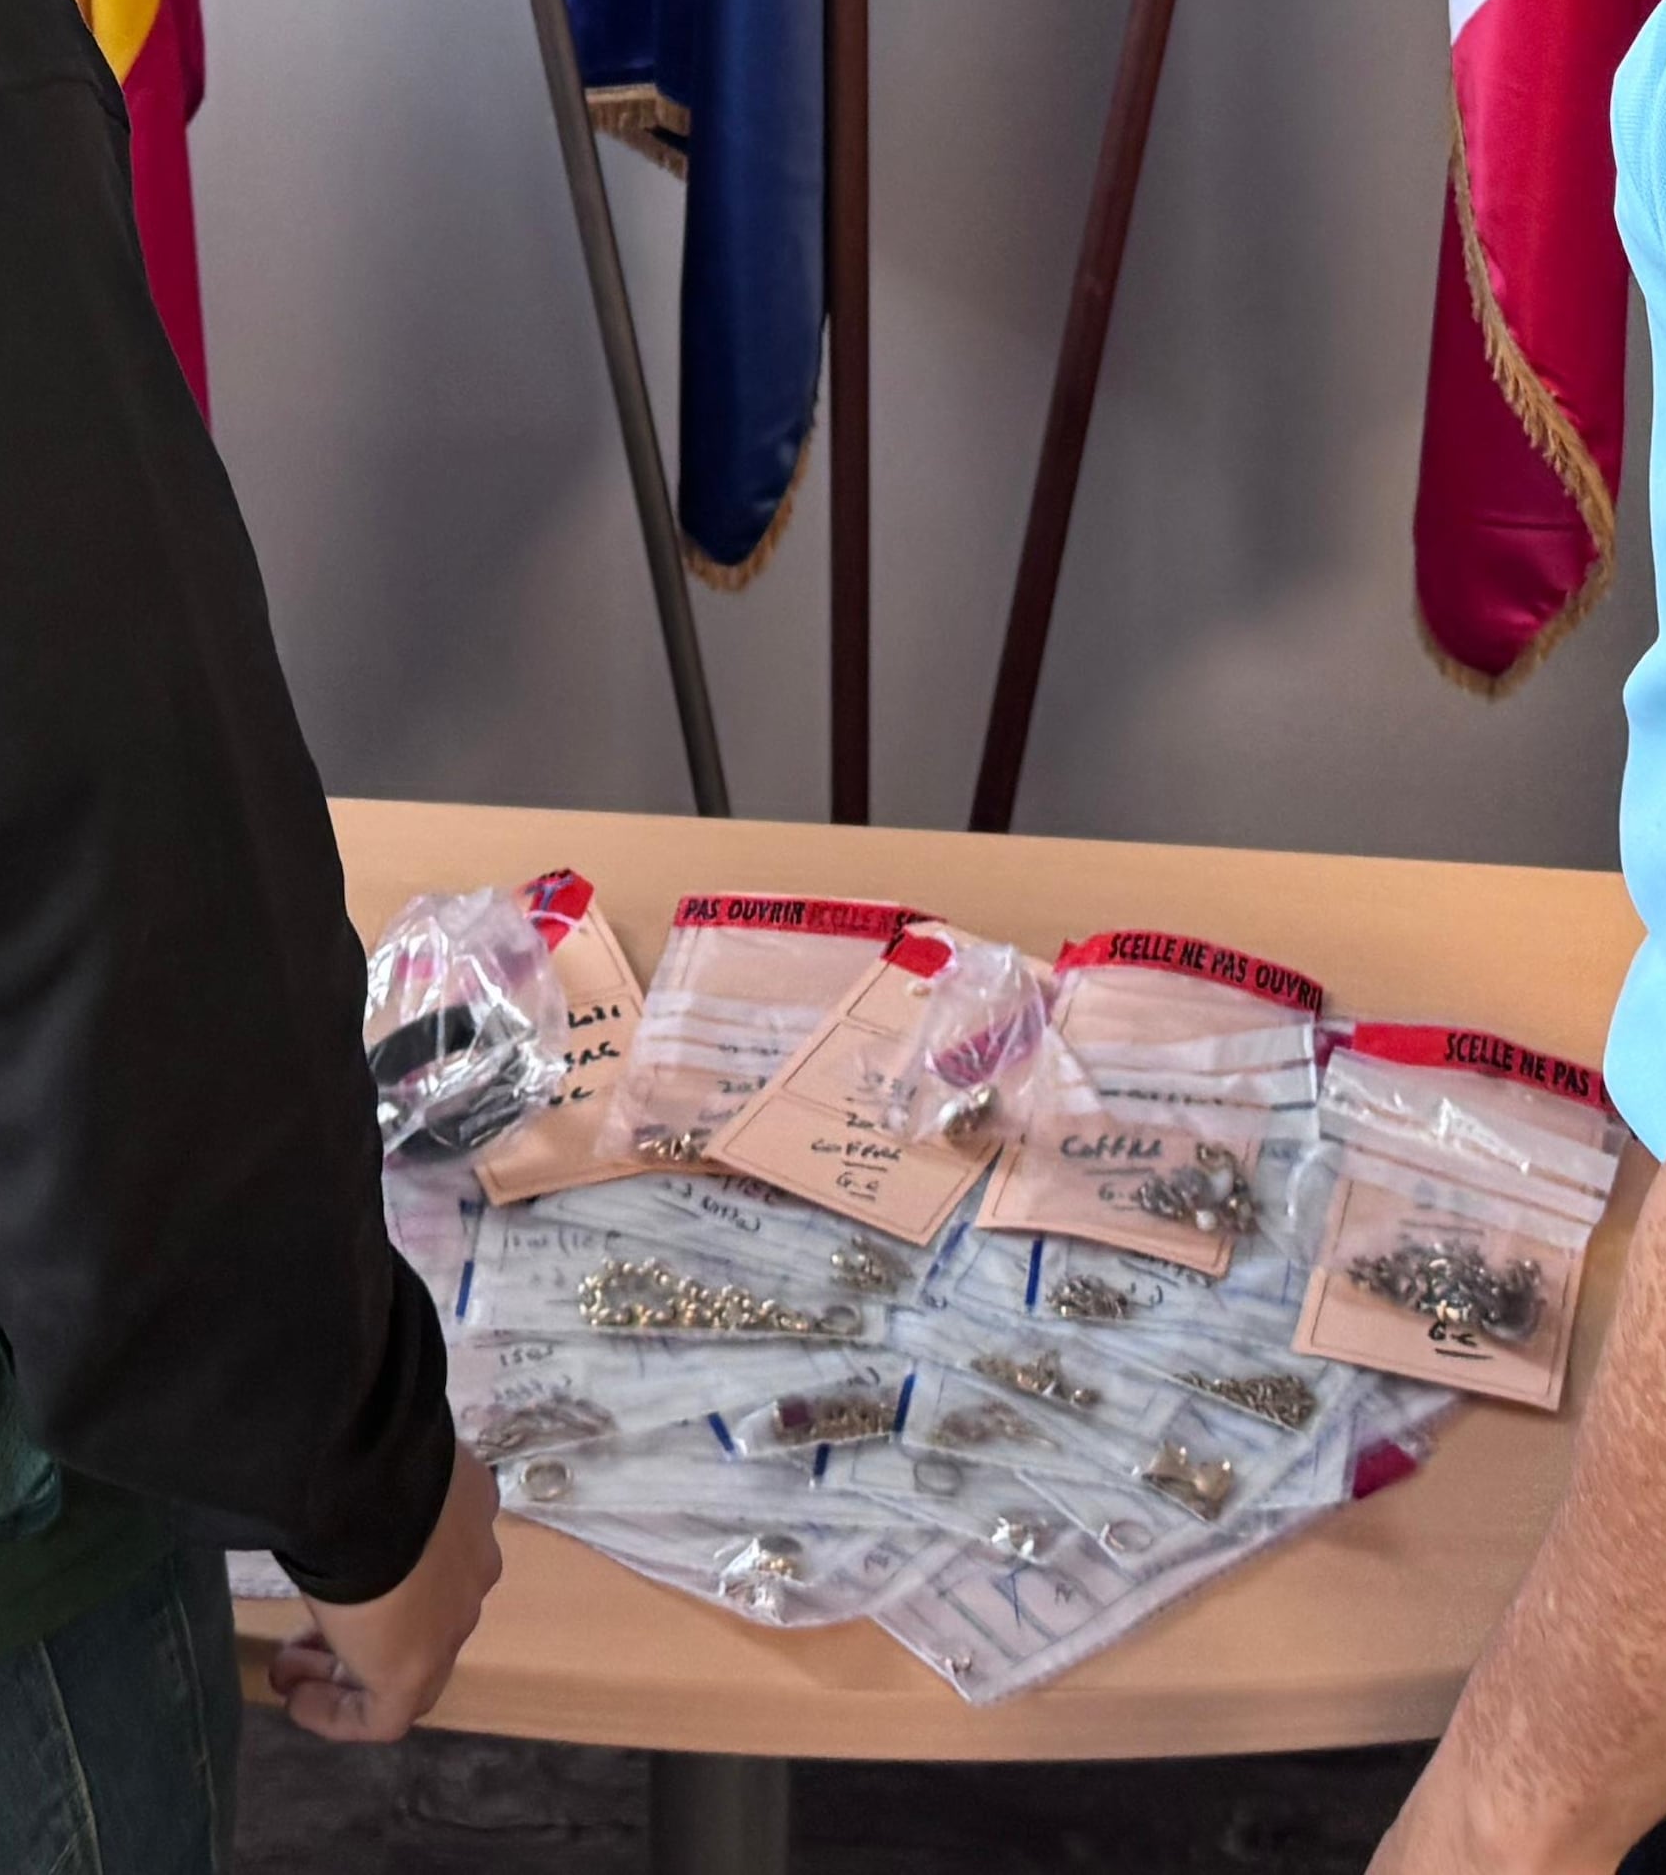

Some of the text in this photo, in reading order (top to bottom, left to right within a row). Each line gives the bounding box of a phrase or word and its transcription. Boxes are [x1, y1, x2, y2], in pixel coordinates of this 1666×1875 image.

[684, 899, 720, 921] PAS
[727, 899, 806, 925] OUVRIR
[1109, 933, 1177, 963] SCELLE
[1179, 940, 1207, 972] NE
[1211, 950, 1248, 984] PAS
[1444, 1032, 1515, 1072] SCELLE
[1519, 1049, 1547, 1083] NE
[1553, 1061, 1589, 1097] PAS
